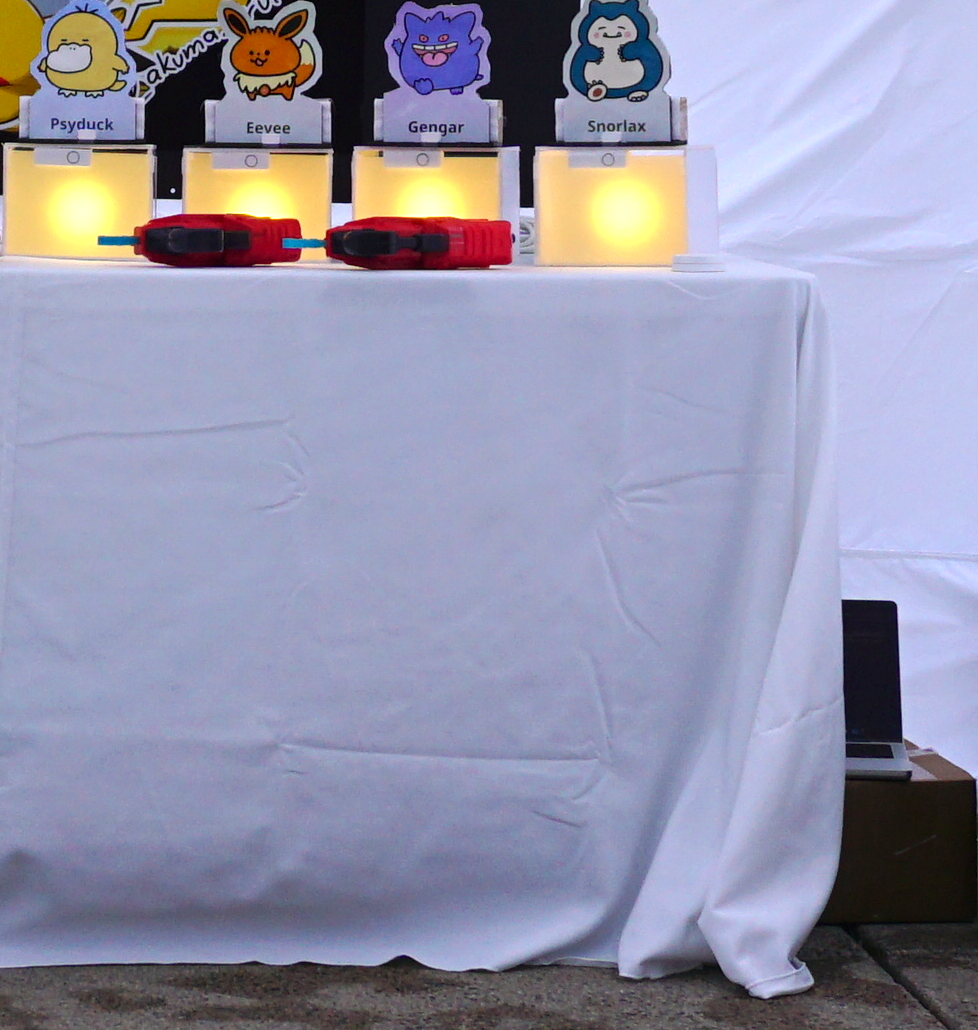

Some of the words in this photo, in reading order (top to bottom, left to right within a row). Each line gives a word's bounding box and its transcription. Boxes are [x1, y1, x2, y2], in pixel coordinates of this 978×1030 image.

[50, 118, 114, 133] Psyduck
[246, 121, 291, 134] Eevee
[408, 120, 465, 137] Gengar
[587, 119, 647, 133] Snorlax
